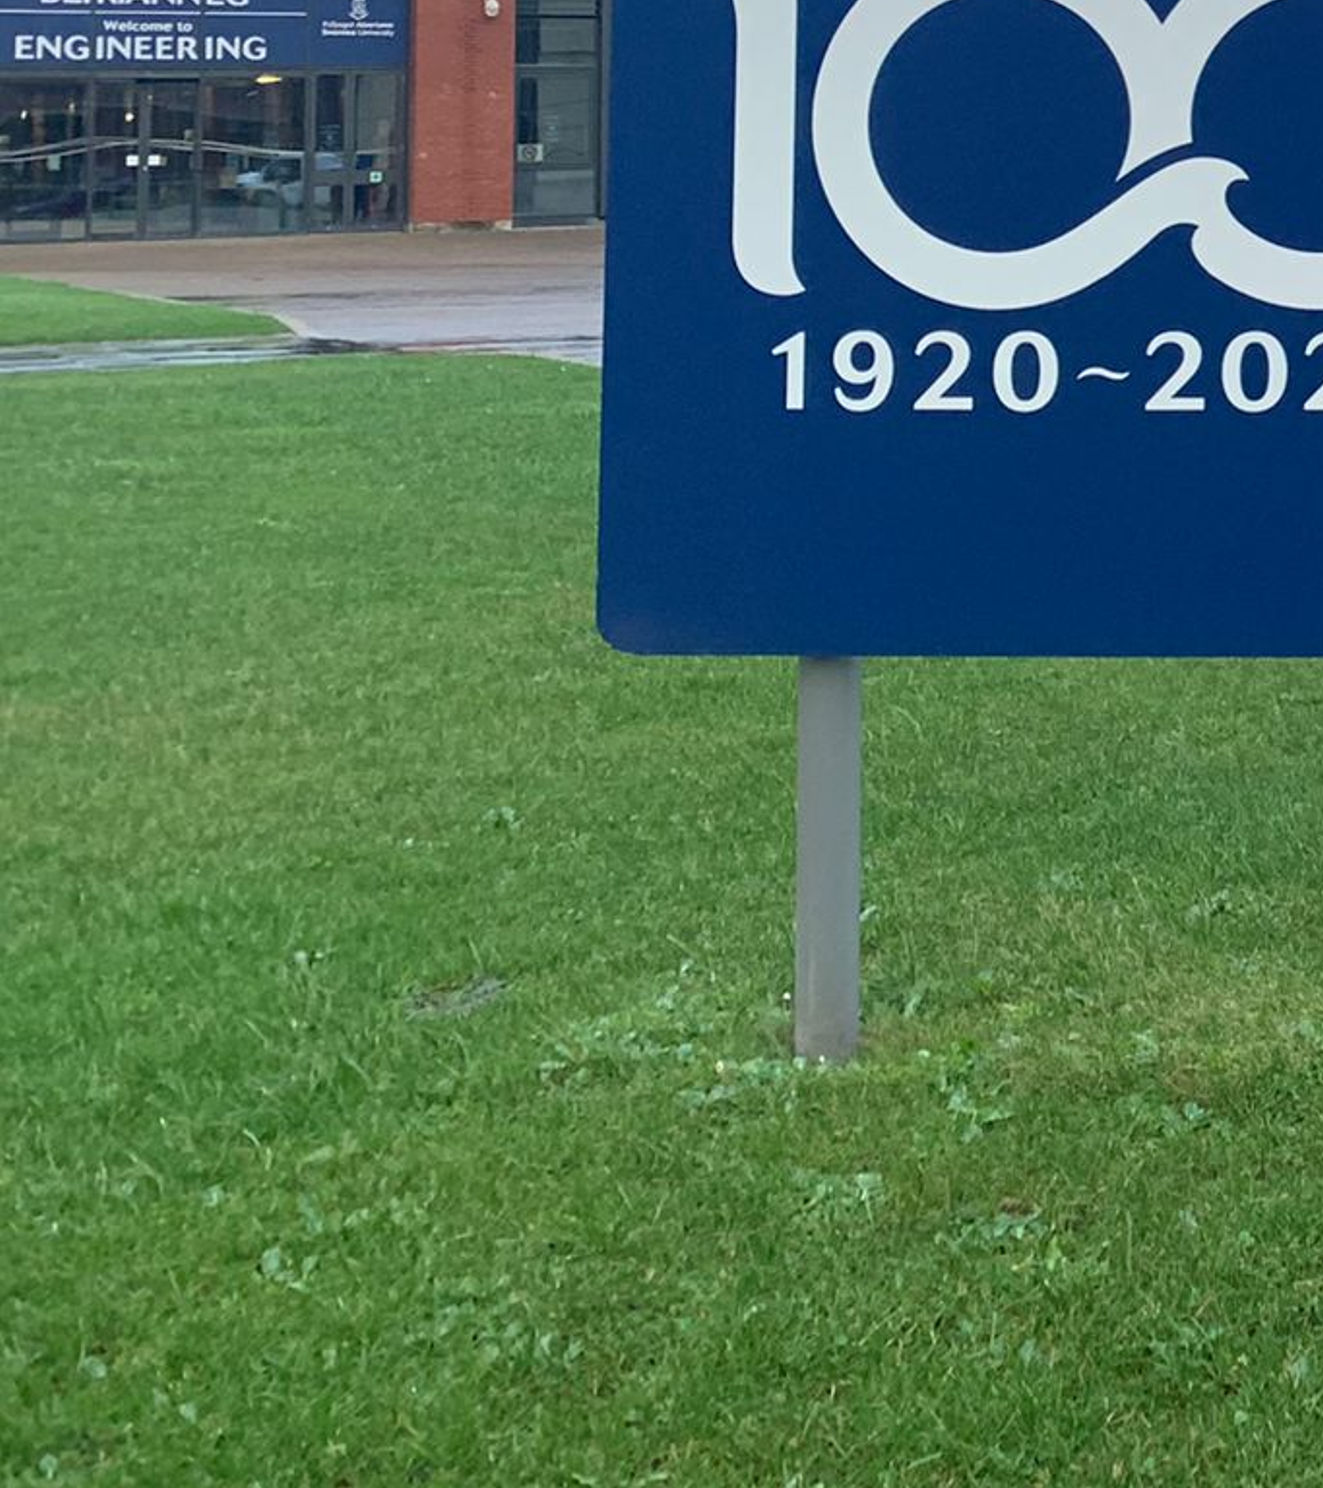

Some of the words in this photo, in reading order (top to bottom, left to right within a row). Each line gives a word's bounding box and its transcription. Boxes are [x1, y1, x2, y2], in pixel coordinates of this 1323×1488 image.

[103, 19, 174, 33] Welcome
[176, 20, 194, 33] to
[14, 35, 268, 61] ENGINEERING
